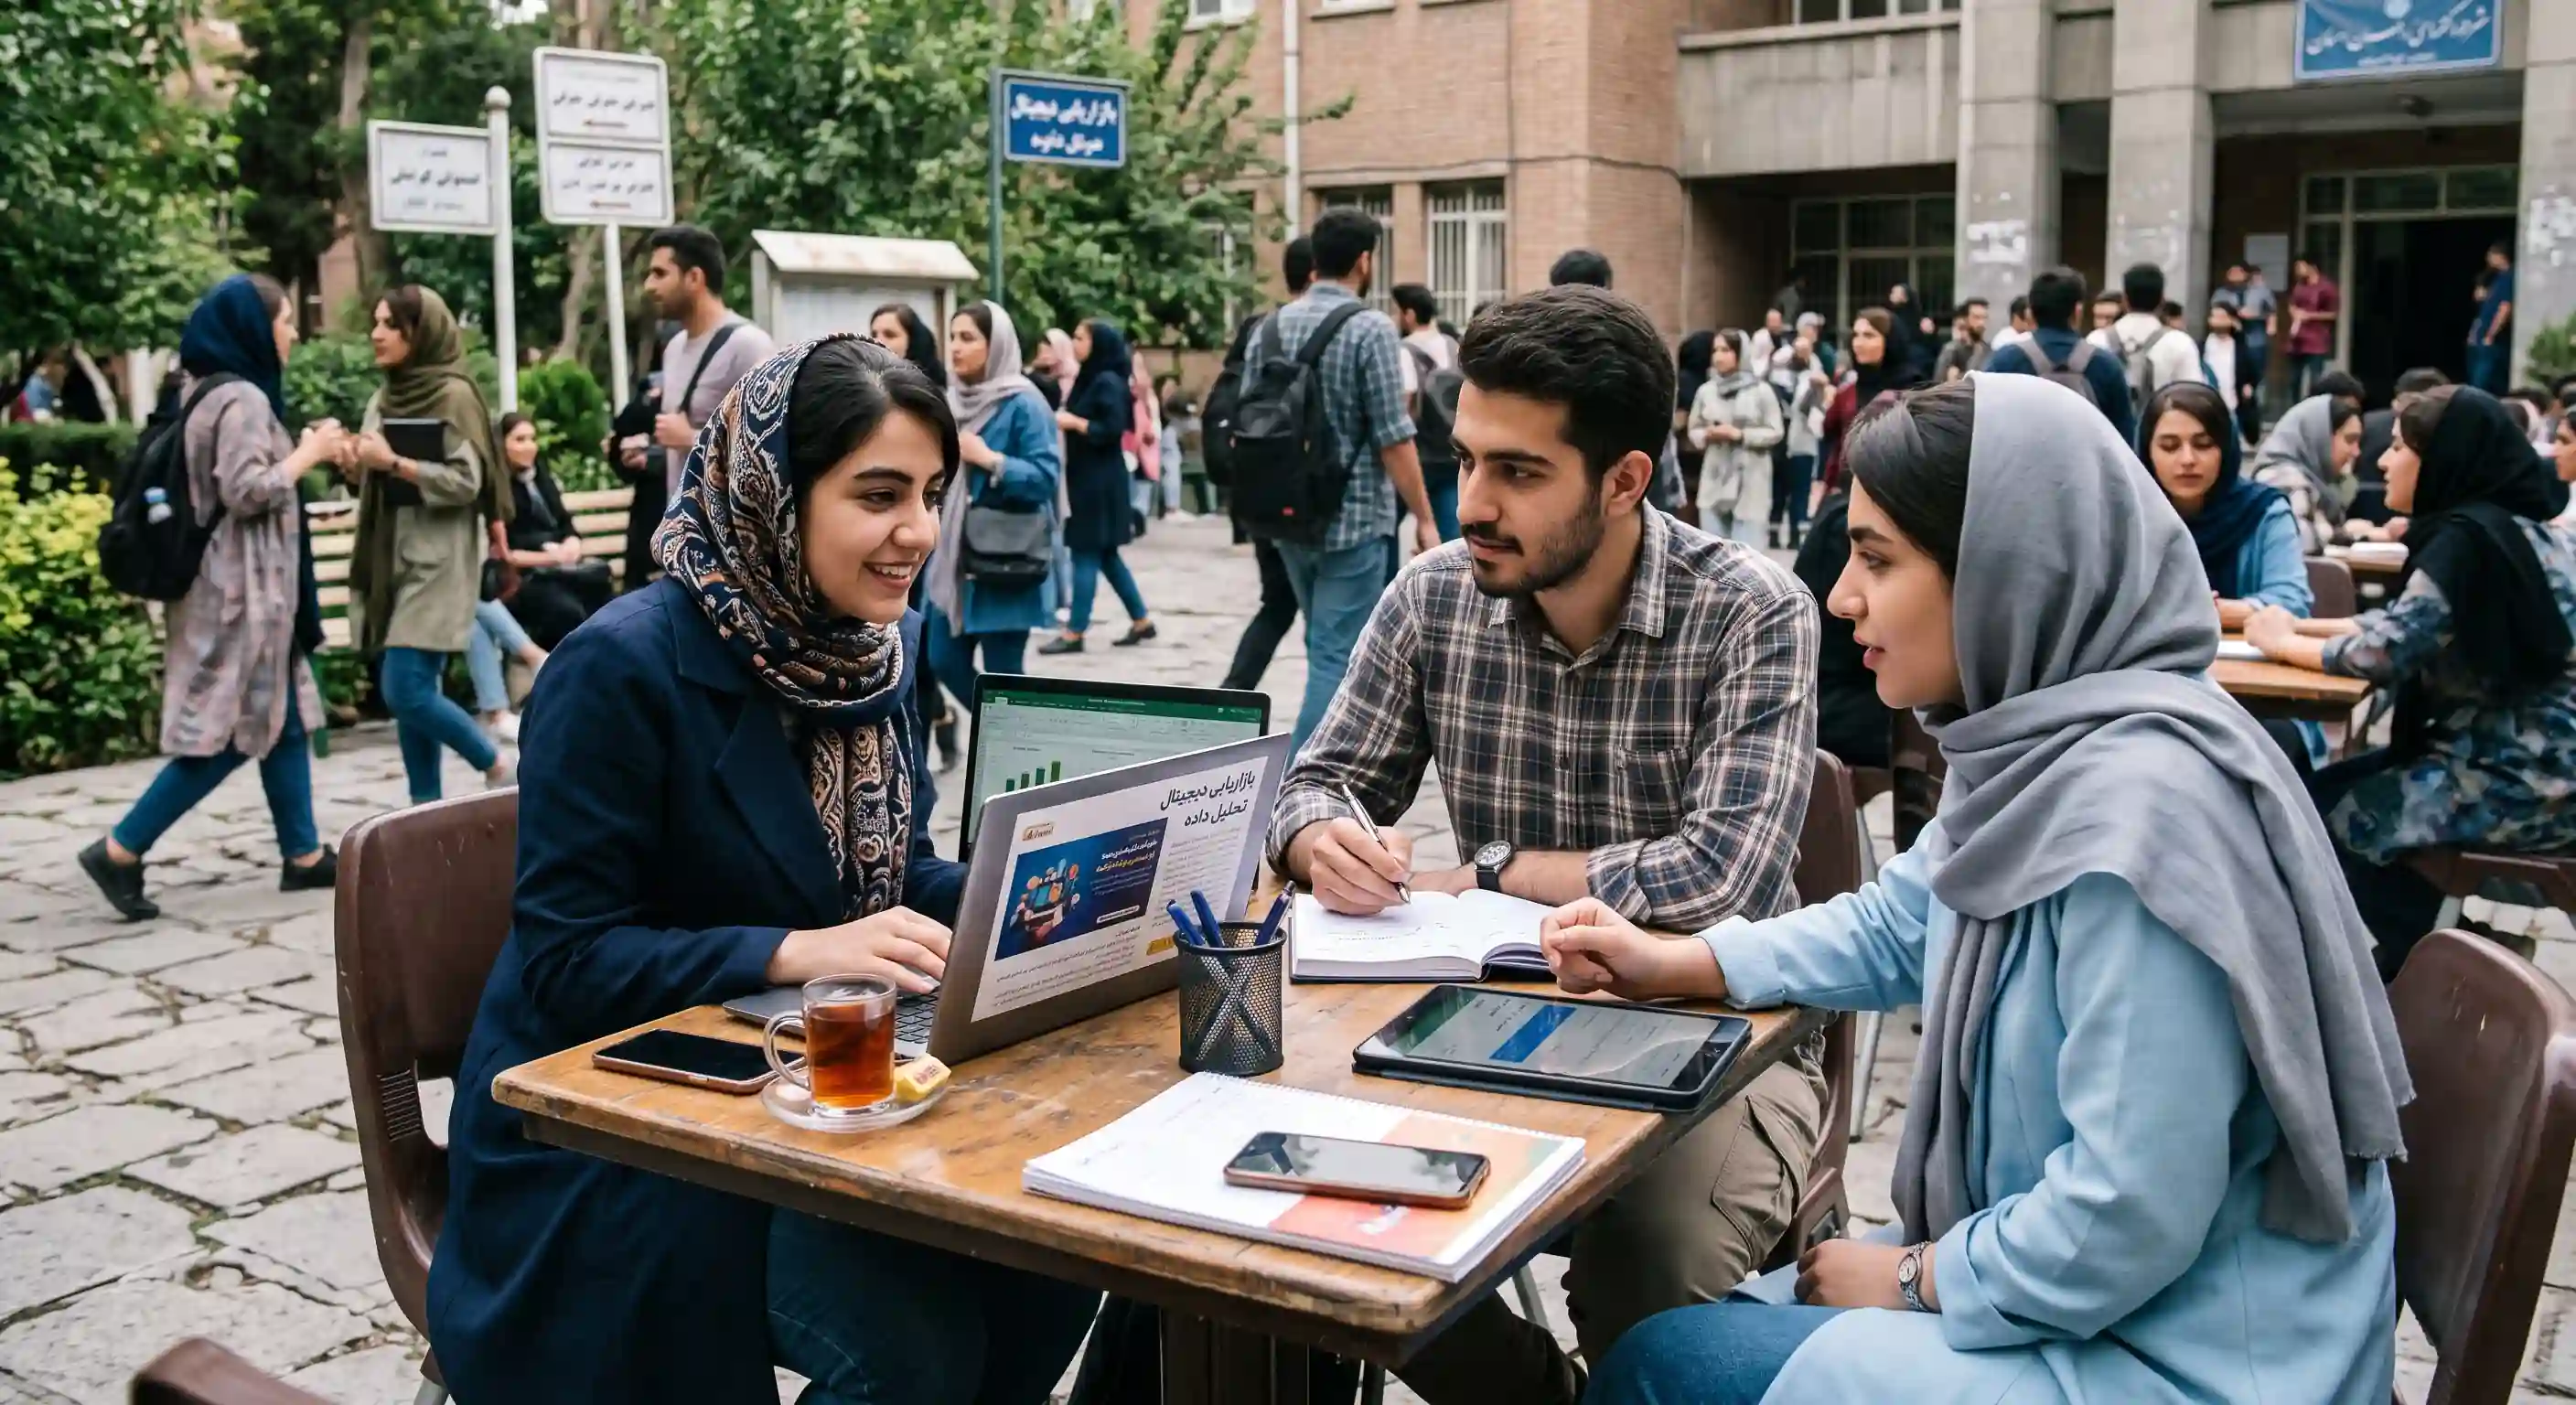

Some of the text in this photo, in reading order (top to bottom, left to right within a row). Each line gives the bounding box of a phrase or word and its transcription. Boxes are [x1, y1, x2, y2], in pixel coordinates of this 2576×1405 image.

[1160, 770, 1256, 811] بازاریابی دیجیتال
[1184, 799, 1249, 827] تحلیل داده
